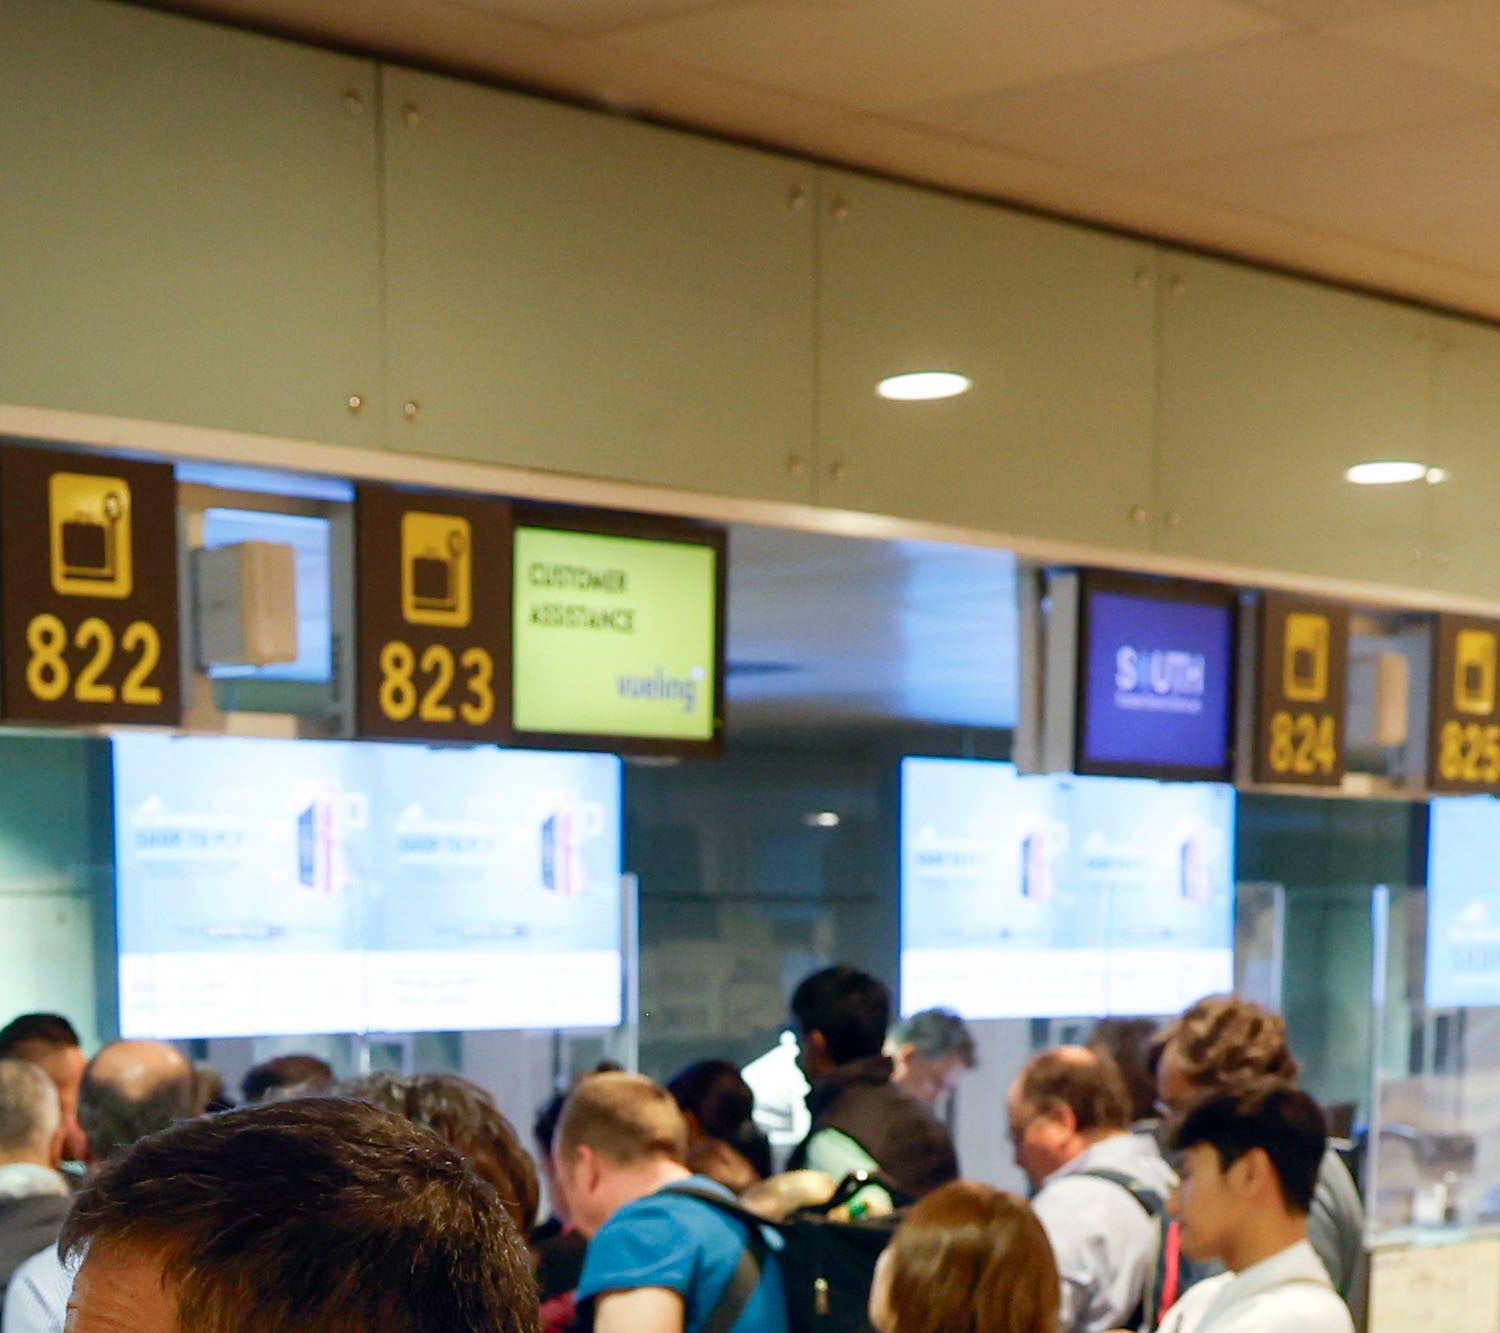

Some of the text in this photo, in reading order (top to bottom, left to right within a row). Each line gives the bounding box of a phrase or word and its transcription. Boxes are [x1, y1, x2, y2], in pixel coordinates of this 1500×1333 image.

[528, 562, 629, 593] CUSTOMER
[529, 603, 635, 634] ASSISTANCE
[25, 611, 163, 707] 822
[378, 639, 495, 726] 823
[616, 665, 697, 714] vueling
[1269, 711, 1337, 774] 824
